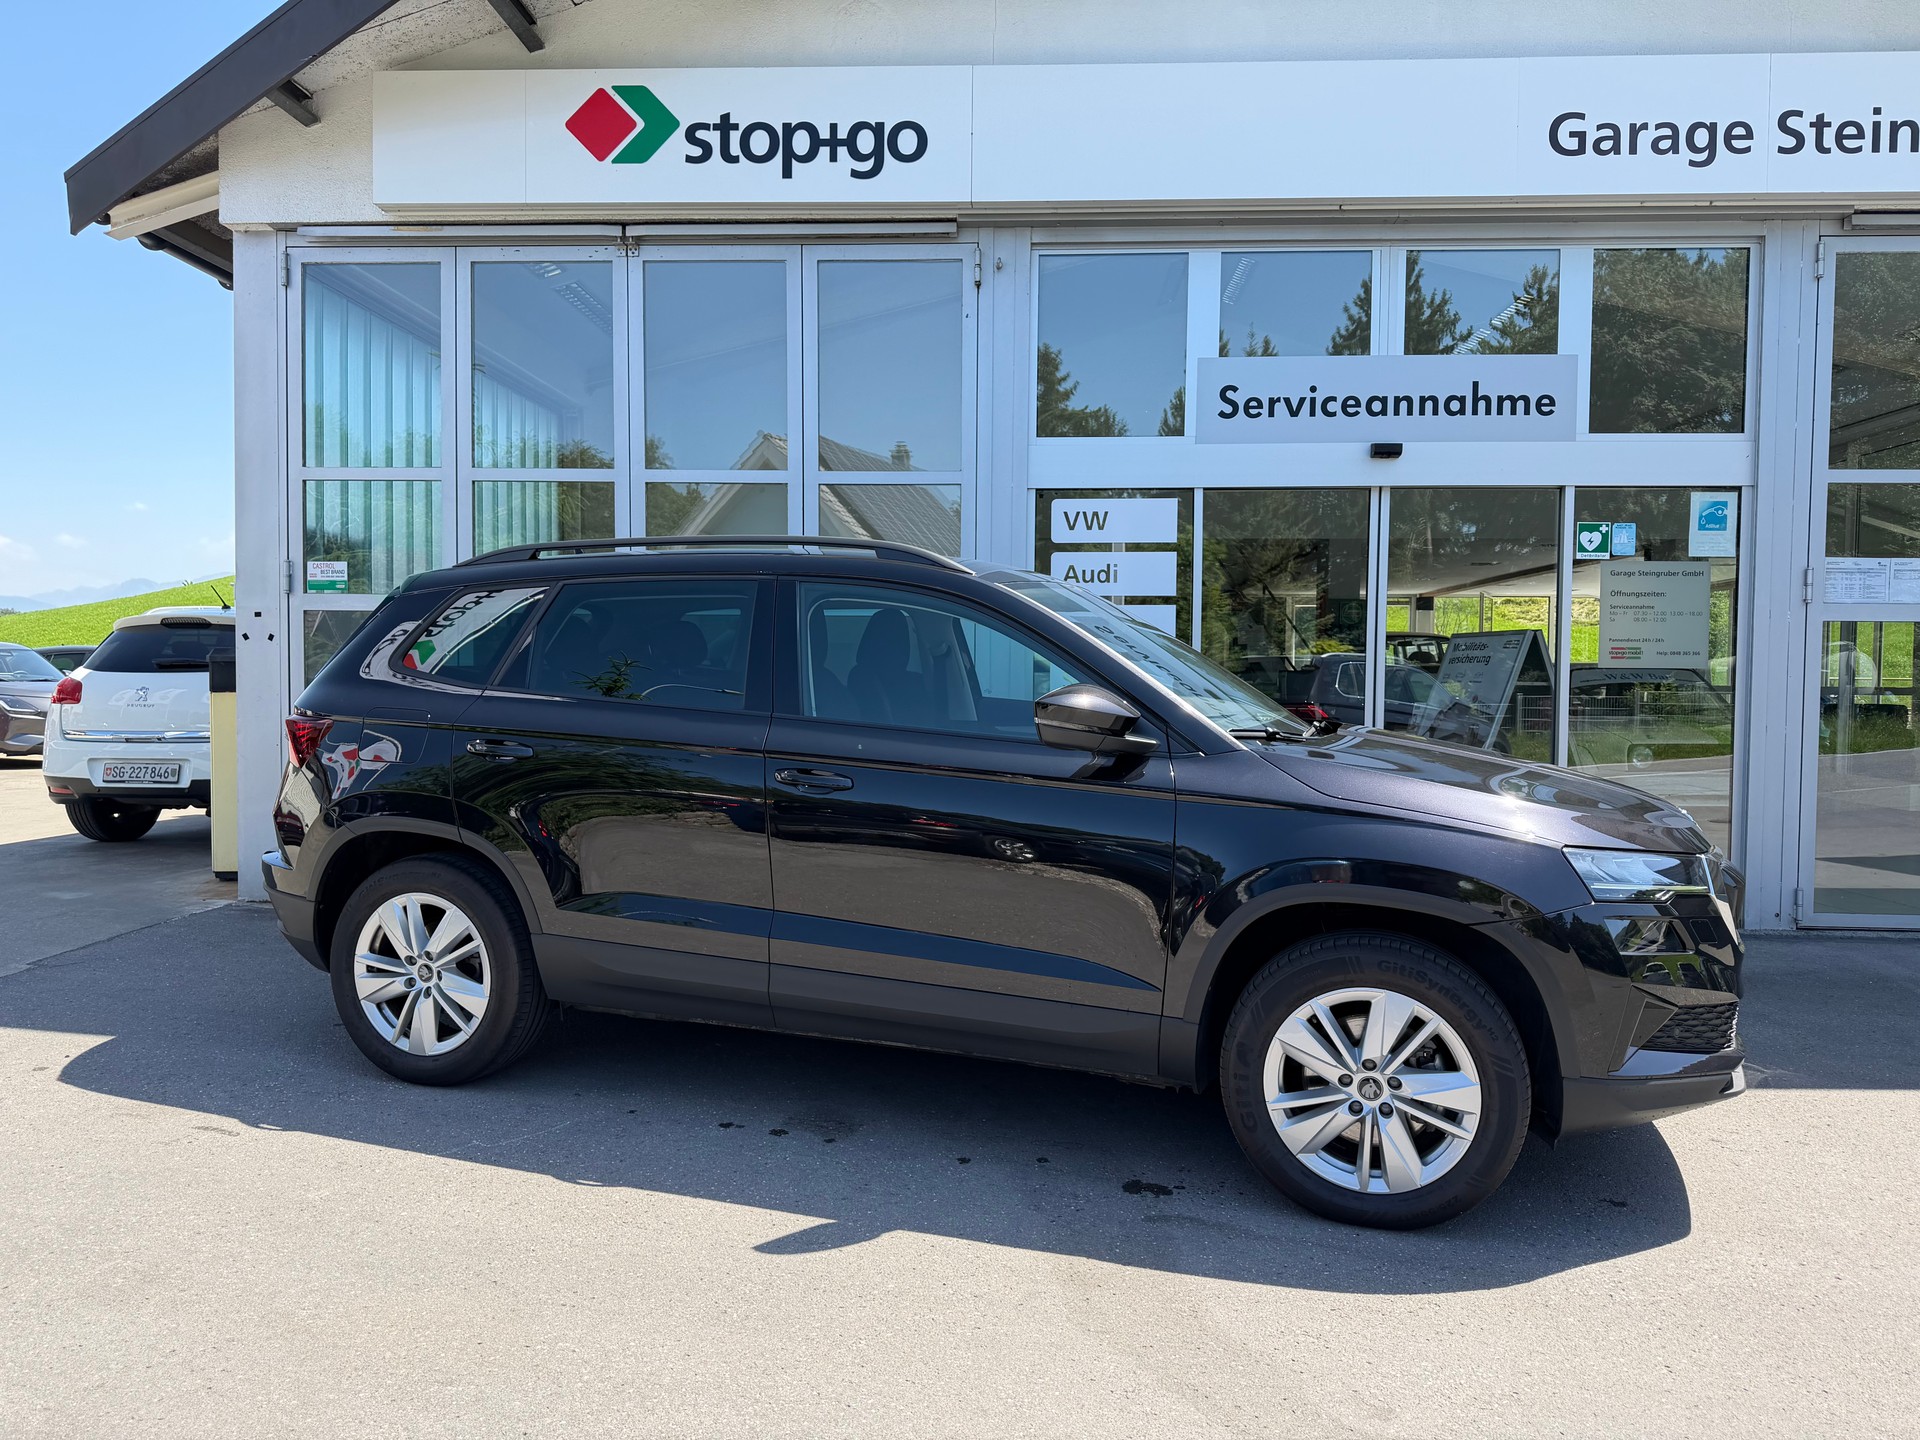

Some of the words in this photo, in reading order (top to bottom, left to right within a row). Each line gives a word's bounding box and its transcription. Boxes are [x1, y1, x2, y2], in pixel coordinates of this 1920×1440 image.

[684, 111, 929, 180] stop+go
[1548, 111, 1755, 168] Garage
[1776, 106, 1920, 155] Stein
[1217, 380, 1557, 420] Serviceannahme
[1063, 511, 1109, 531] VW
[1063, 563, 1118, 584] Audi
[1610, 569, 1636, 578] Garage
[1637, 569, 1680, 578] Steingruber
[1610, 589, 1667, 598] Öffnungszeiten:
[1448, 654, 1491, 665] versicherung
